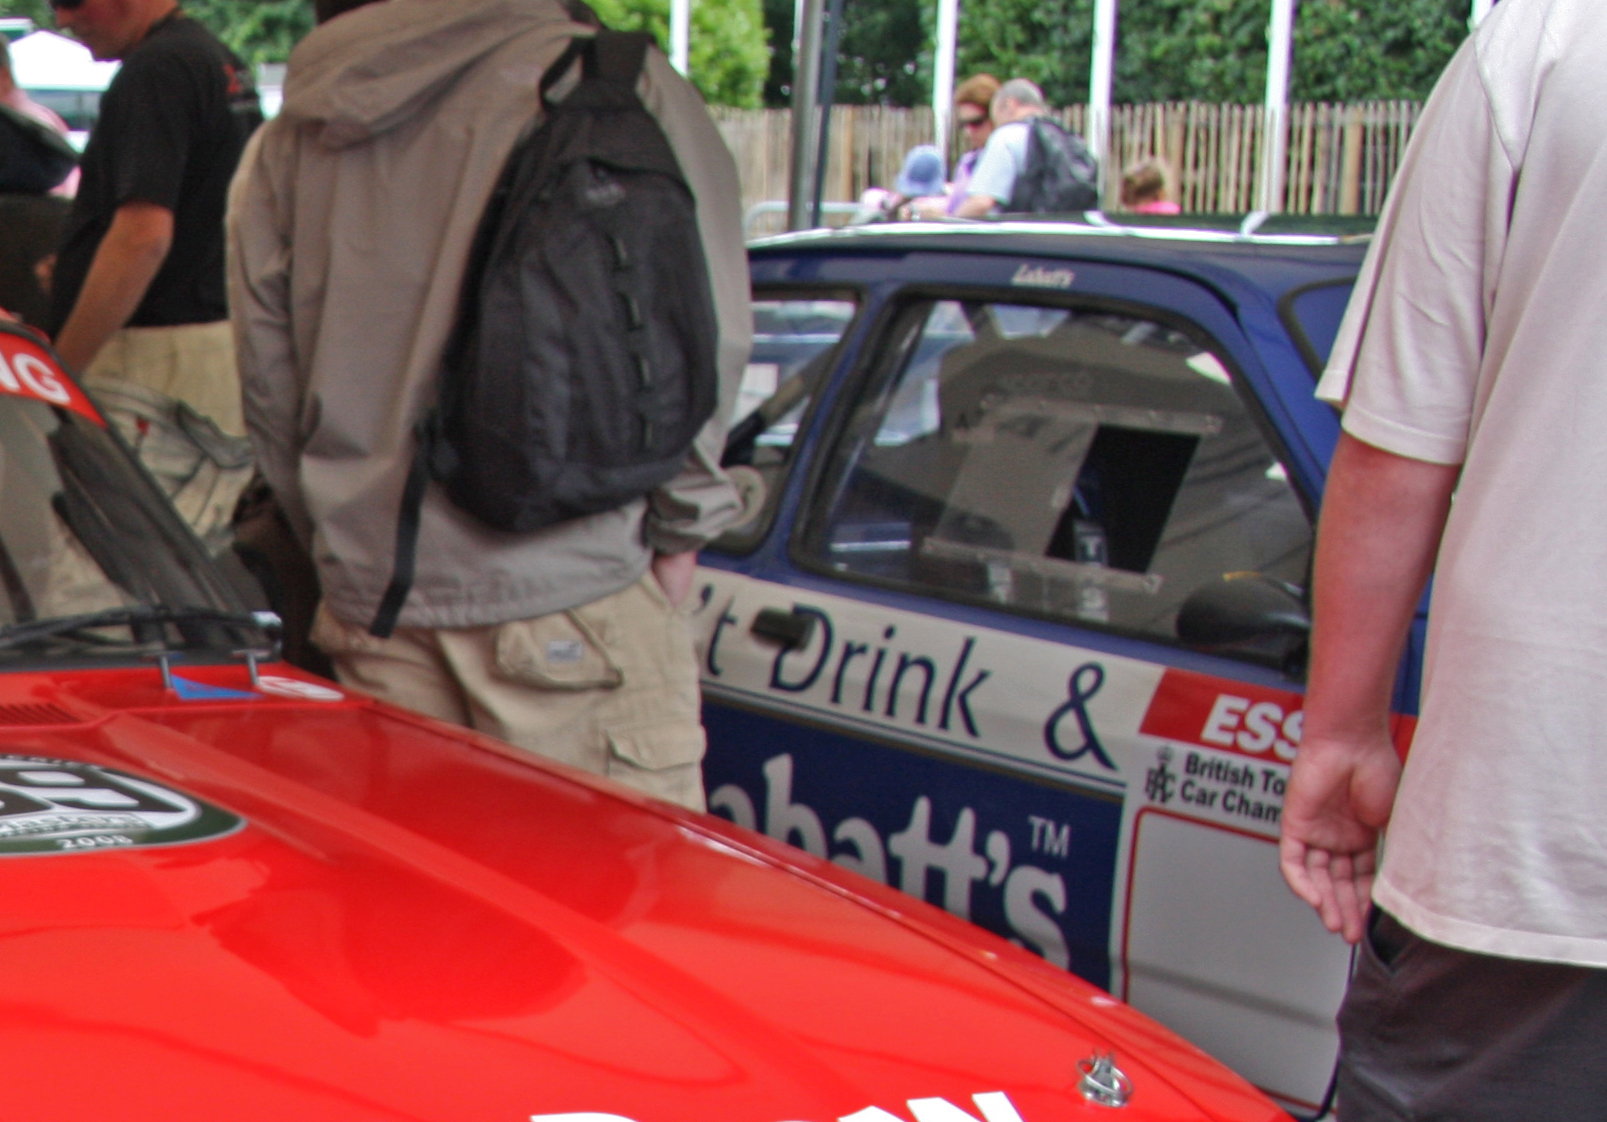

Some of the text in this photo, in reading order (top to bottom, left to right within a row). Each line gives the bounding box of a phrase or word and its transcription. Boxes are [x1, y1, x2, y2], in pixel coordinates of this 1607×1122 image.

[768, 602, 993, 738] Drink
[1042, 661, 1119, 772] &
[1199, 693, 1305, 762] ESS
[1180, 779, 1282, 824] Car Cham
[1184, 752, 1287, 796] British To
